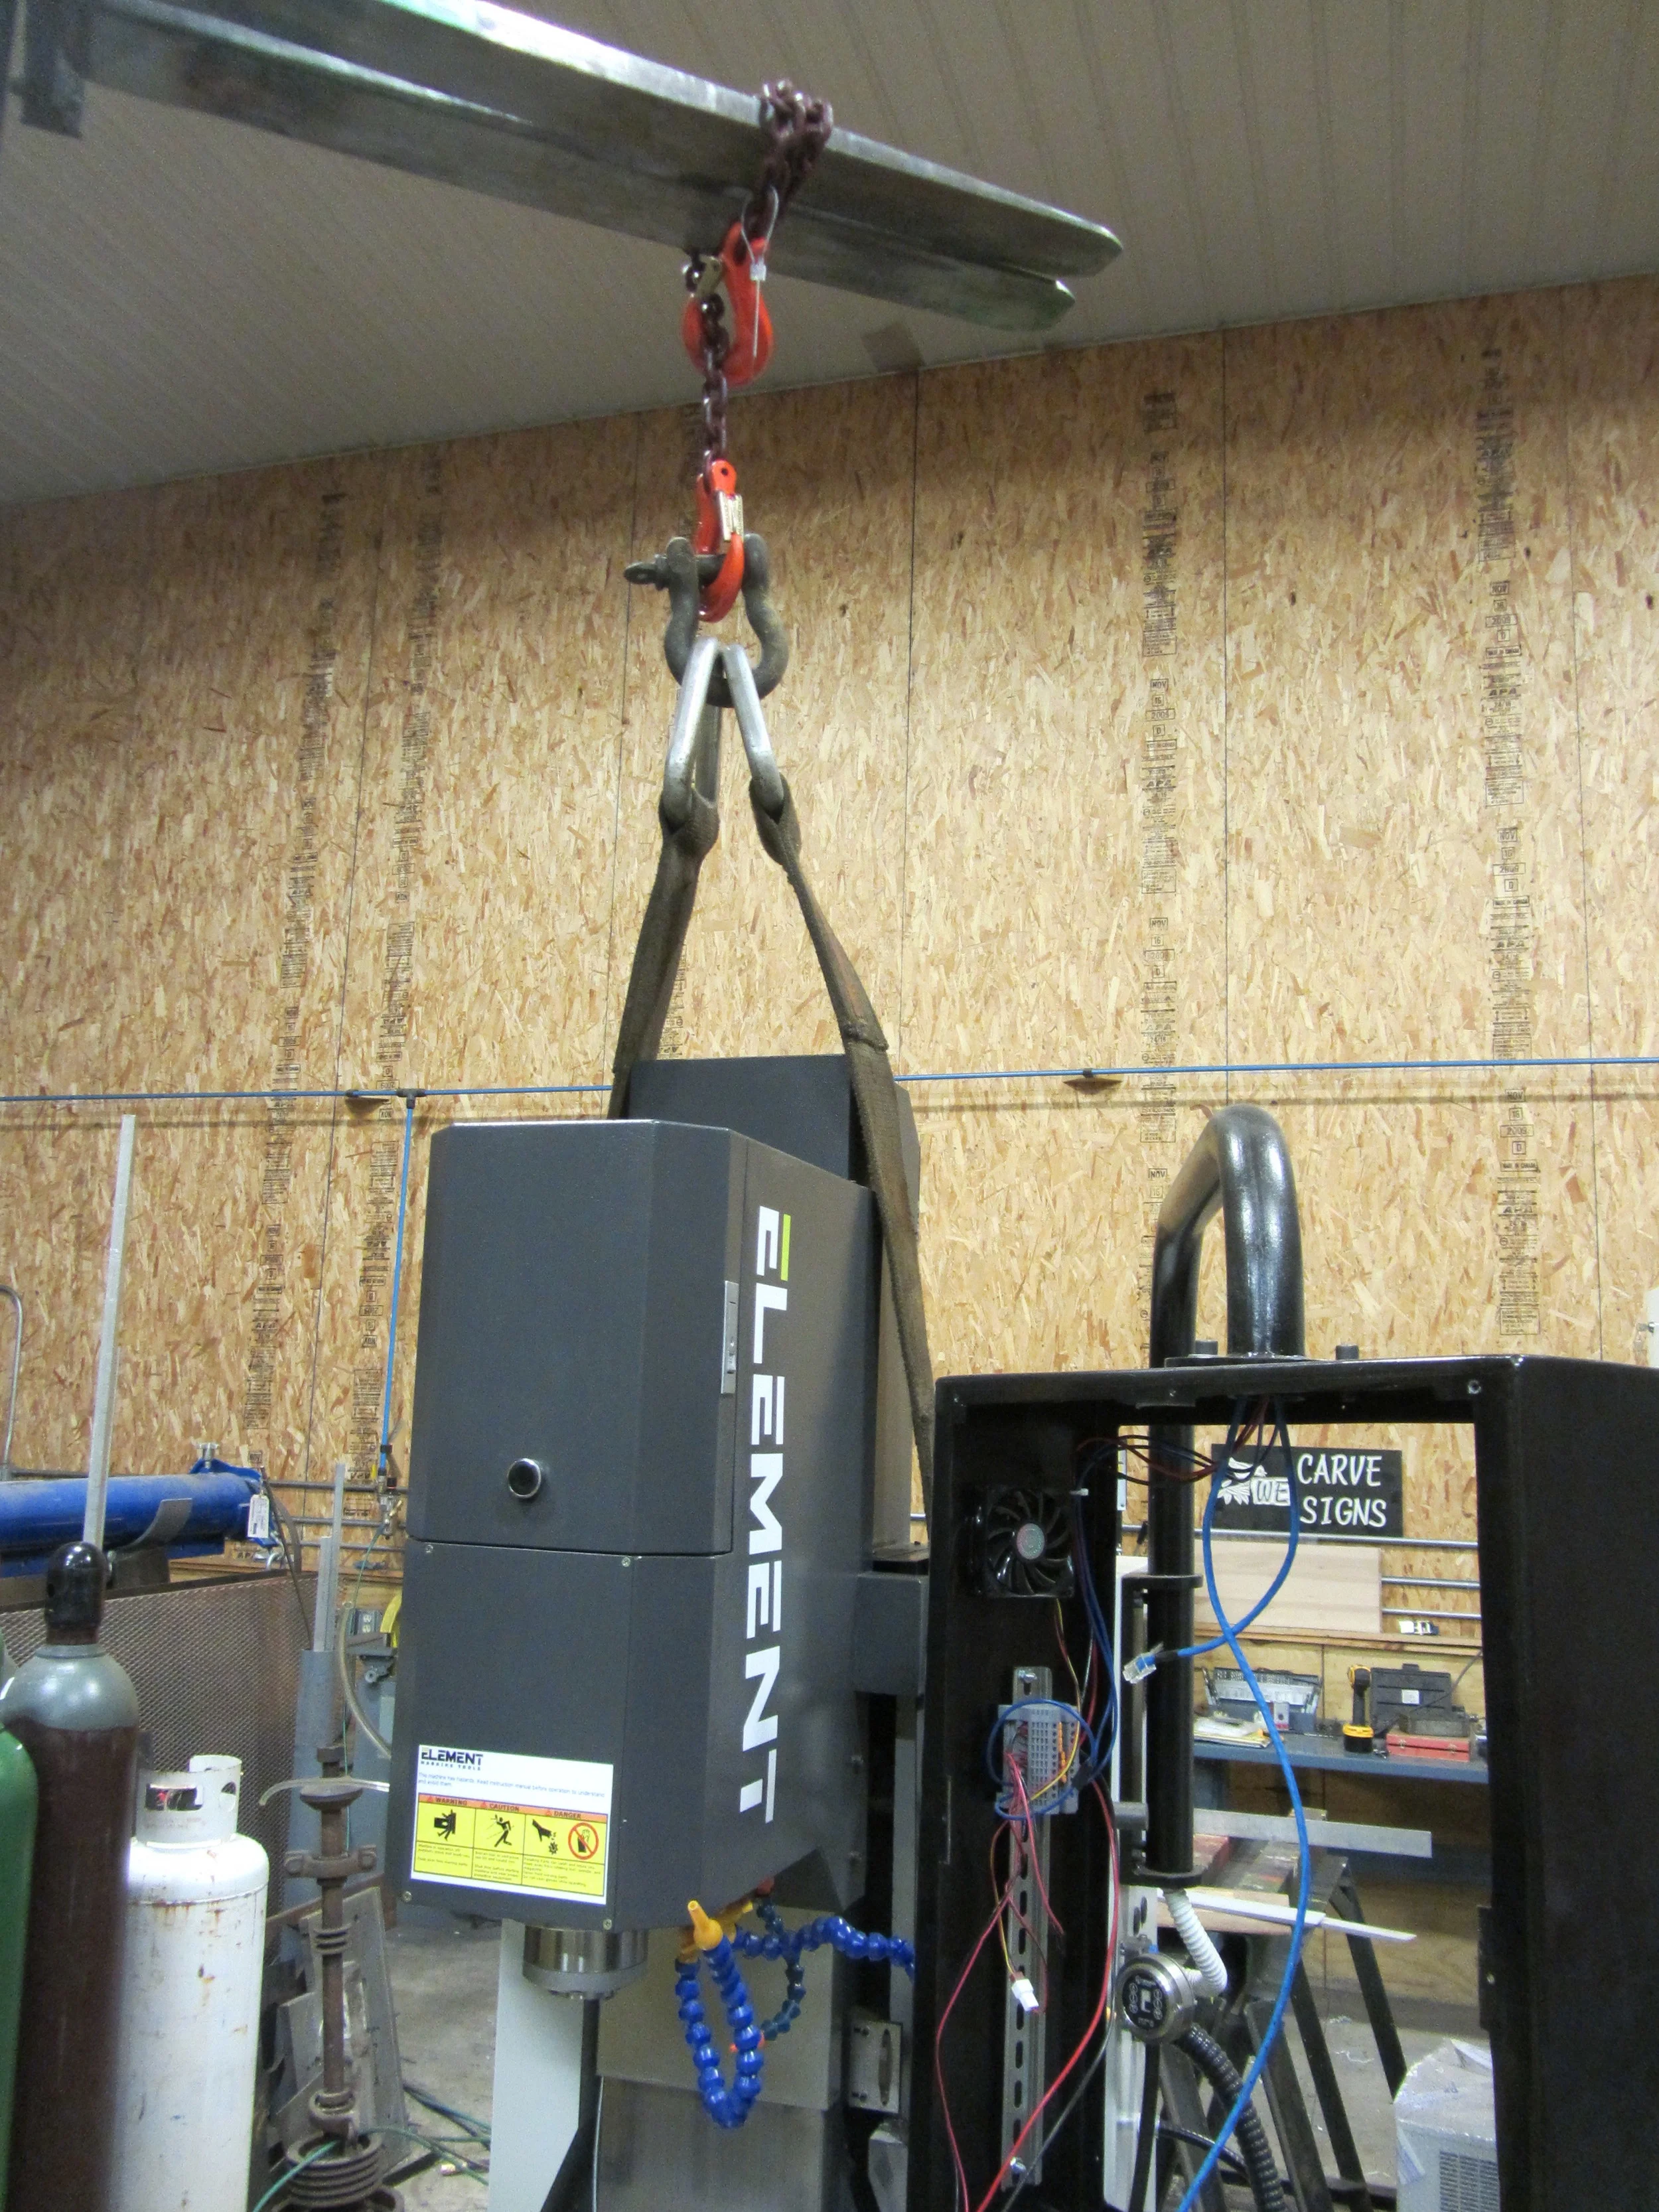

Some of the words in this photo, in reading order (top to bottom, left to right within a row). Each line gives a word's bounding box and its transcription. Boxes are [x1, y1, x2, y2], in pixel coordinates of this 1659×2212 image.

[1488, 688, 1517, 696] APA
[1297, 1453, 1383, 1487] CARVE
[1256, 1481, 1289, 1503] WE
[739, 1205, 792, 1824] ELEMENT
[1299, 1495, 1388, 1528] SIGNS
[421, 1747, 484, 1766] ELEMENT
[435, 1797, 468, 1806] WARNING
[489, 1803, 520, 1812] CAUTION
[553, 1810, 582, 1818] DANGER
